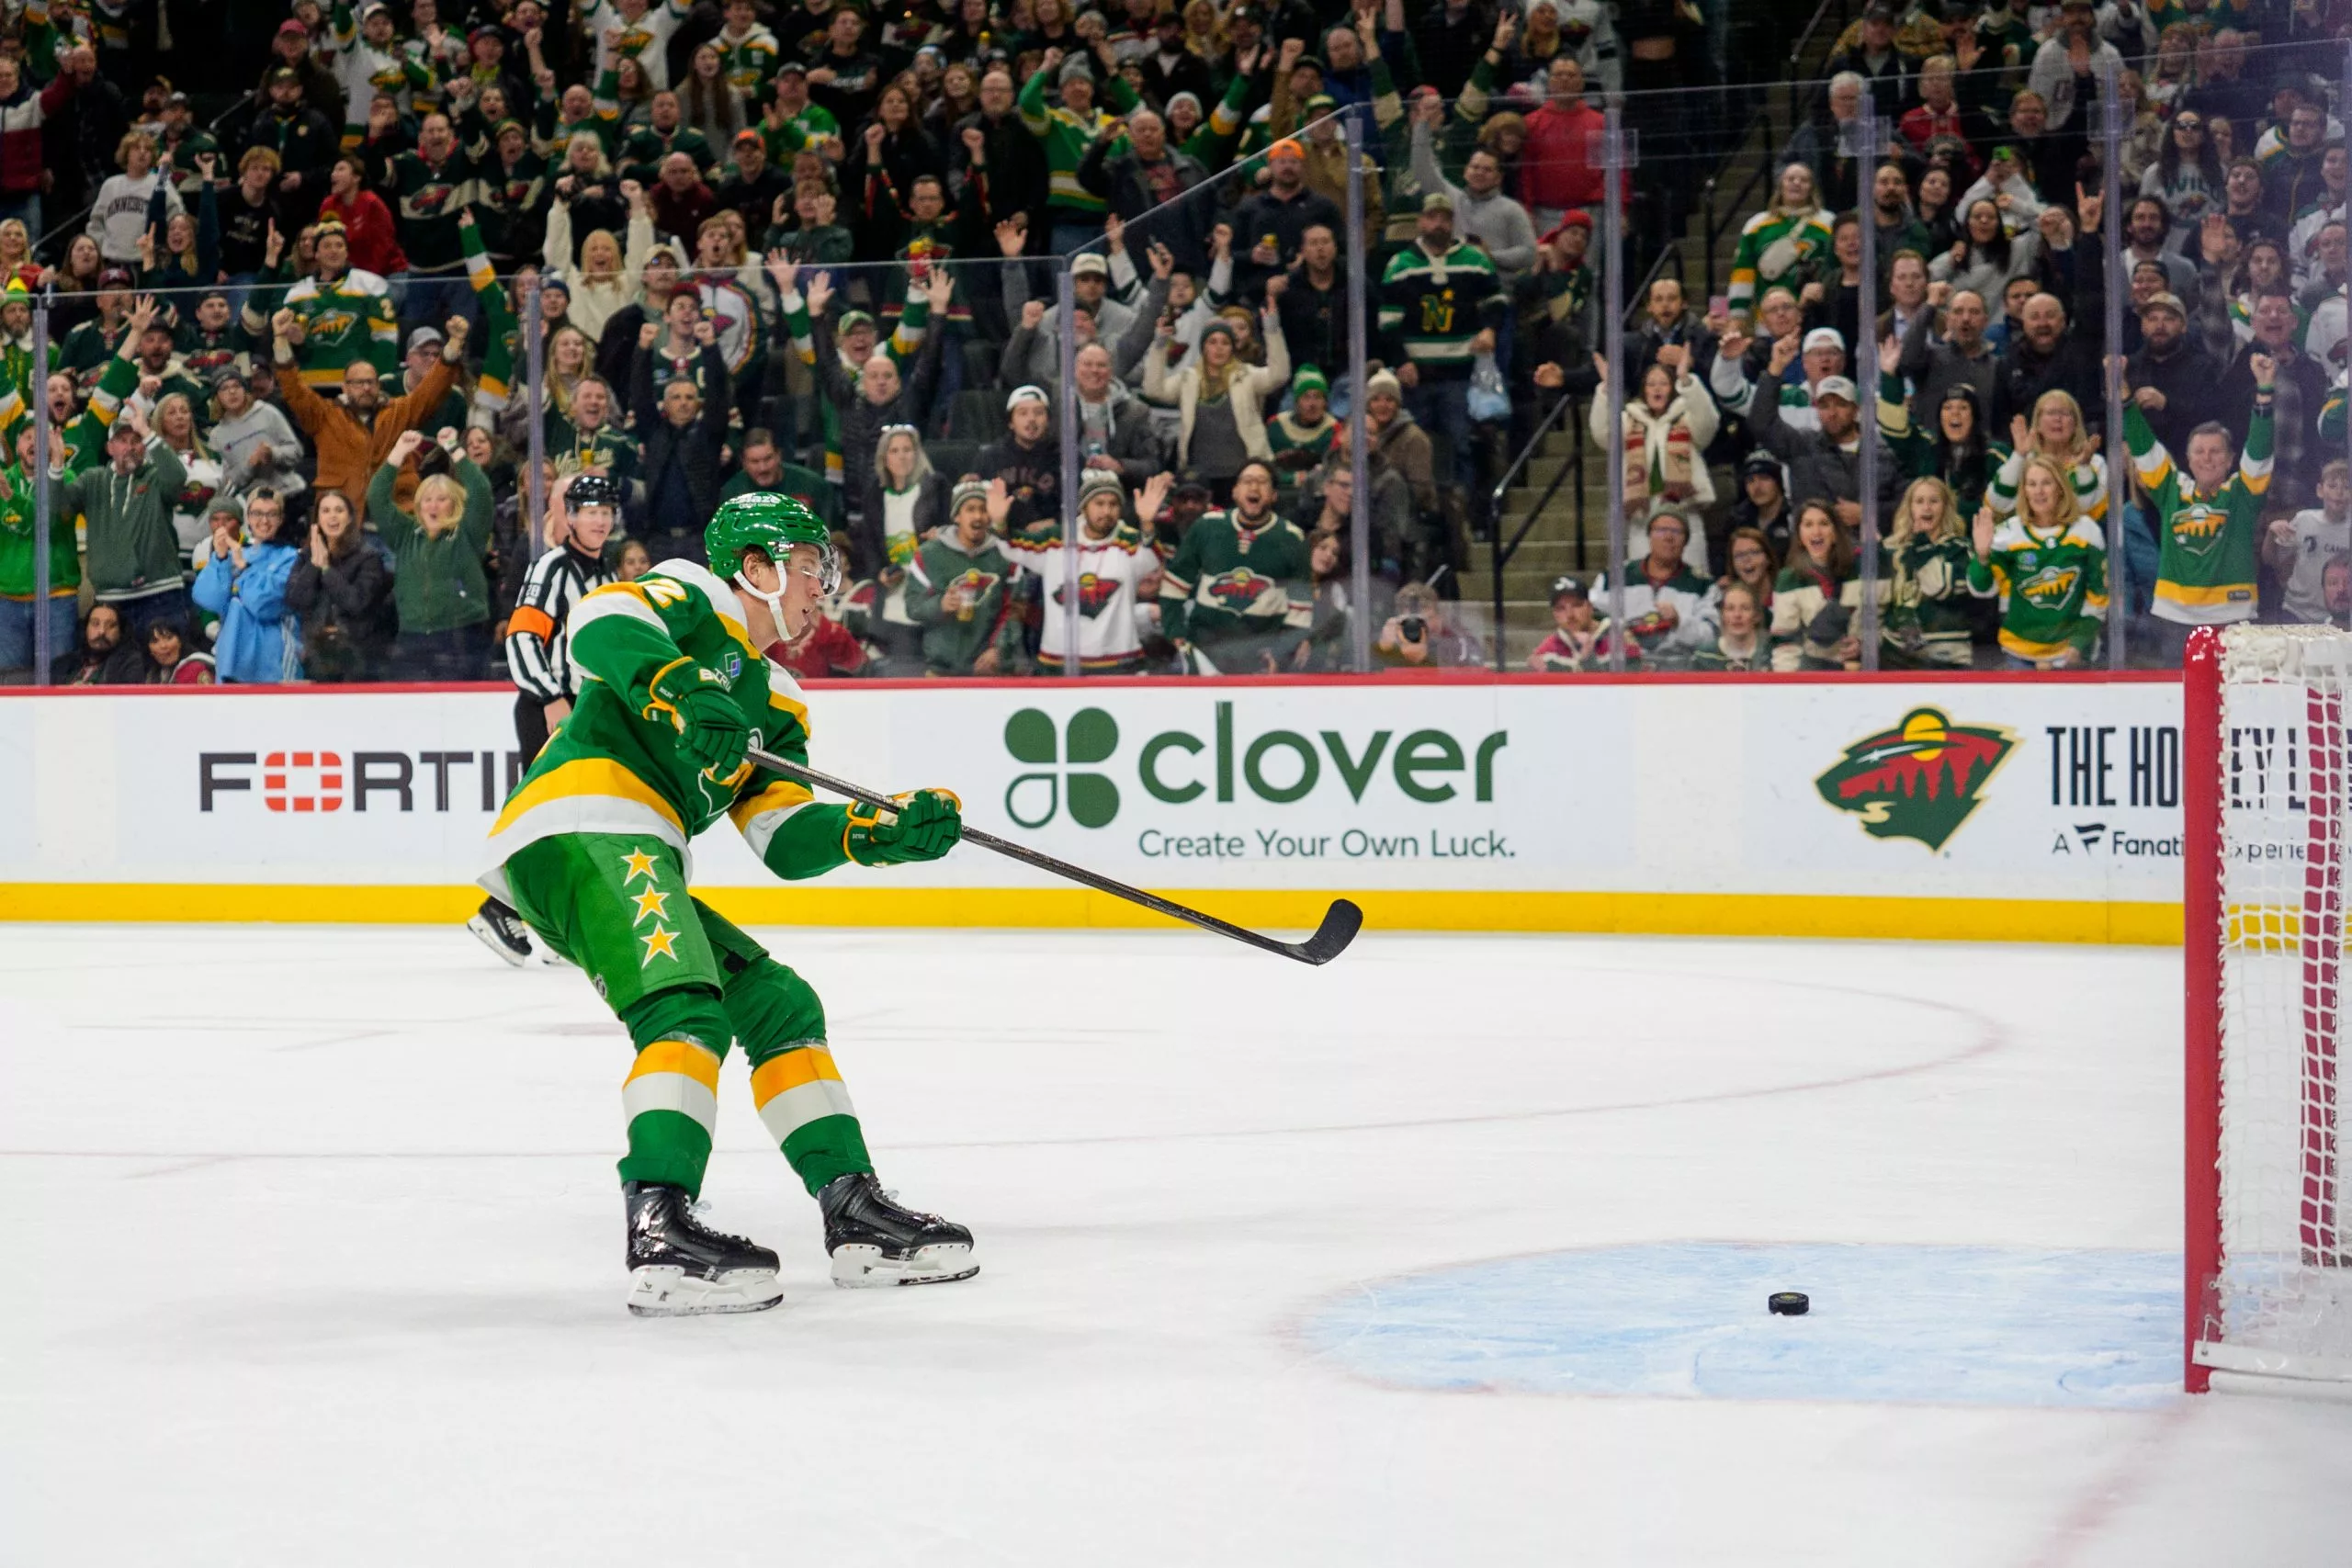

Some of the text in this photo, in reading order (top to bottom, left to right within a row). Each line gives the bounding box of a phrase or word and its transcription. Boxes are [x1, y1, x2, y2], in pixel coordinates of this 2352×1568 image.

[199, 750, 523, 812] FORTI
[1138, 701, 1508, 805] clover
[2046, 727, 2117, 807] THE
[1138, 829, 1516, 857] Create Your Own Luck.
[2052, 833, 2070, 854] A
[2113, 830, 2185, 856] Fanati
